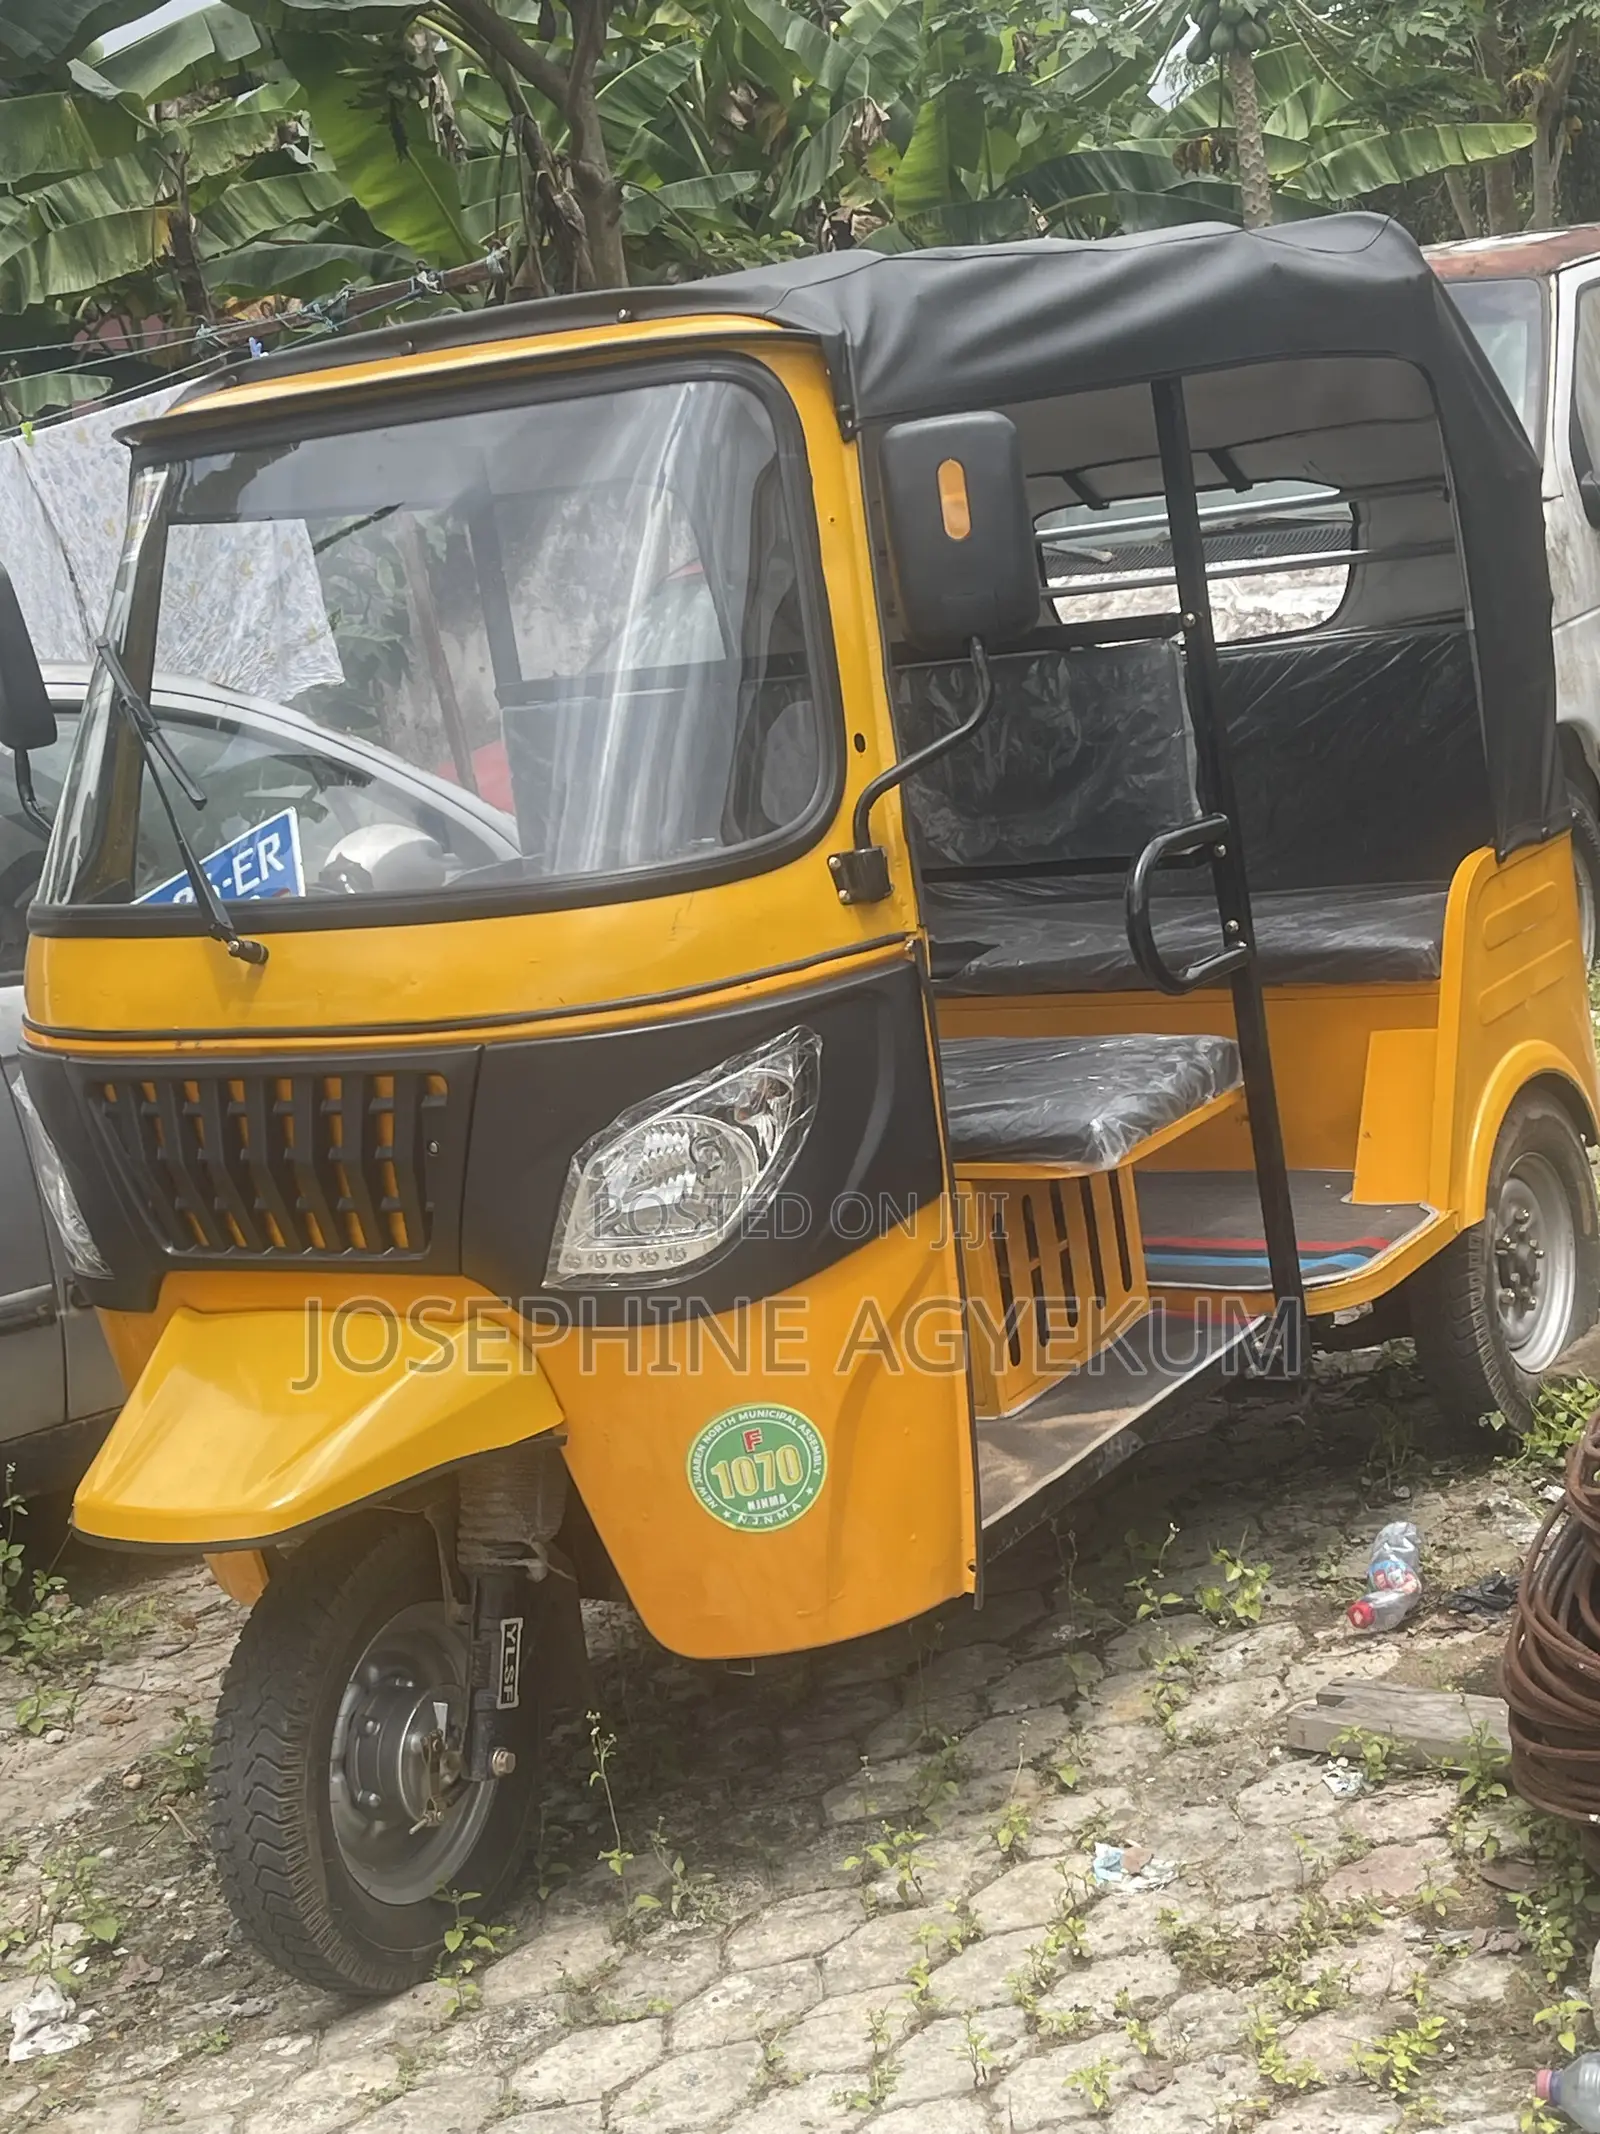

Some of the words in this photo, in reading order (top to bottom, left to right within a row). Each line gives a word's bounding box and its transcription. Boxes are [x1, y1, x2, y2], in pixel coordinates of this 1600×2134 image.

[704, 1416, 736, 1445] NORTH
[738, 1409, 798, 1426] MUNICIPAL
[742, 1427, 763, 1452] F
[797, 1423, 822, 1475] ASSEMBLY
[692, 1444, 706, 1484] JUABEN
[710, 1444, 804, 1500] 1070
[696, 1486, 718, 1509] NEW
[503, 1624, 517, 1702] YLSF
